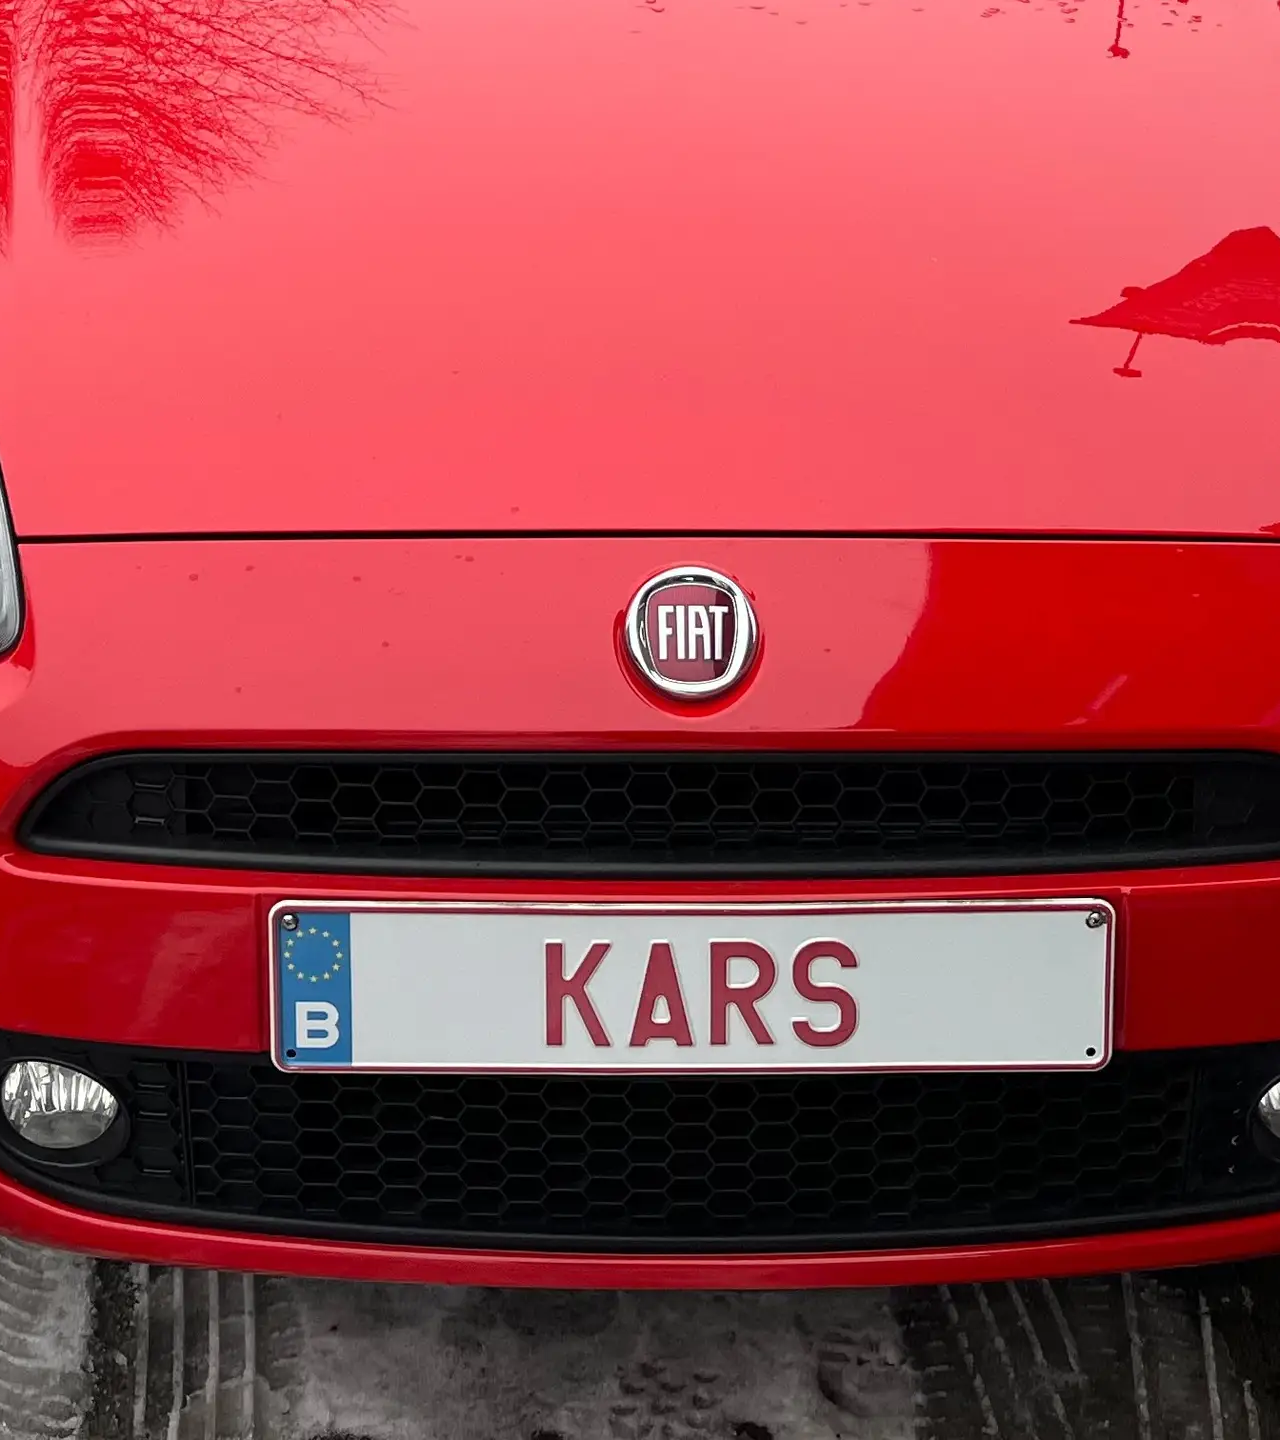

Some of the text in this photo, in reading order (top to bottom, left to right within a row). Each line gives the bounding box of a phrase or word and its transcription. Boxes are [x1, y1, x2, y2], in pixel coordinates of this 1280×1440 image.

[657, 605, 729, 660] FIAT
[295, 938, 860, 1048] B KARS
